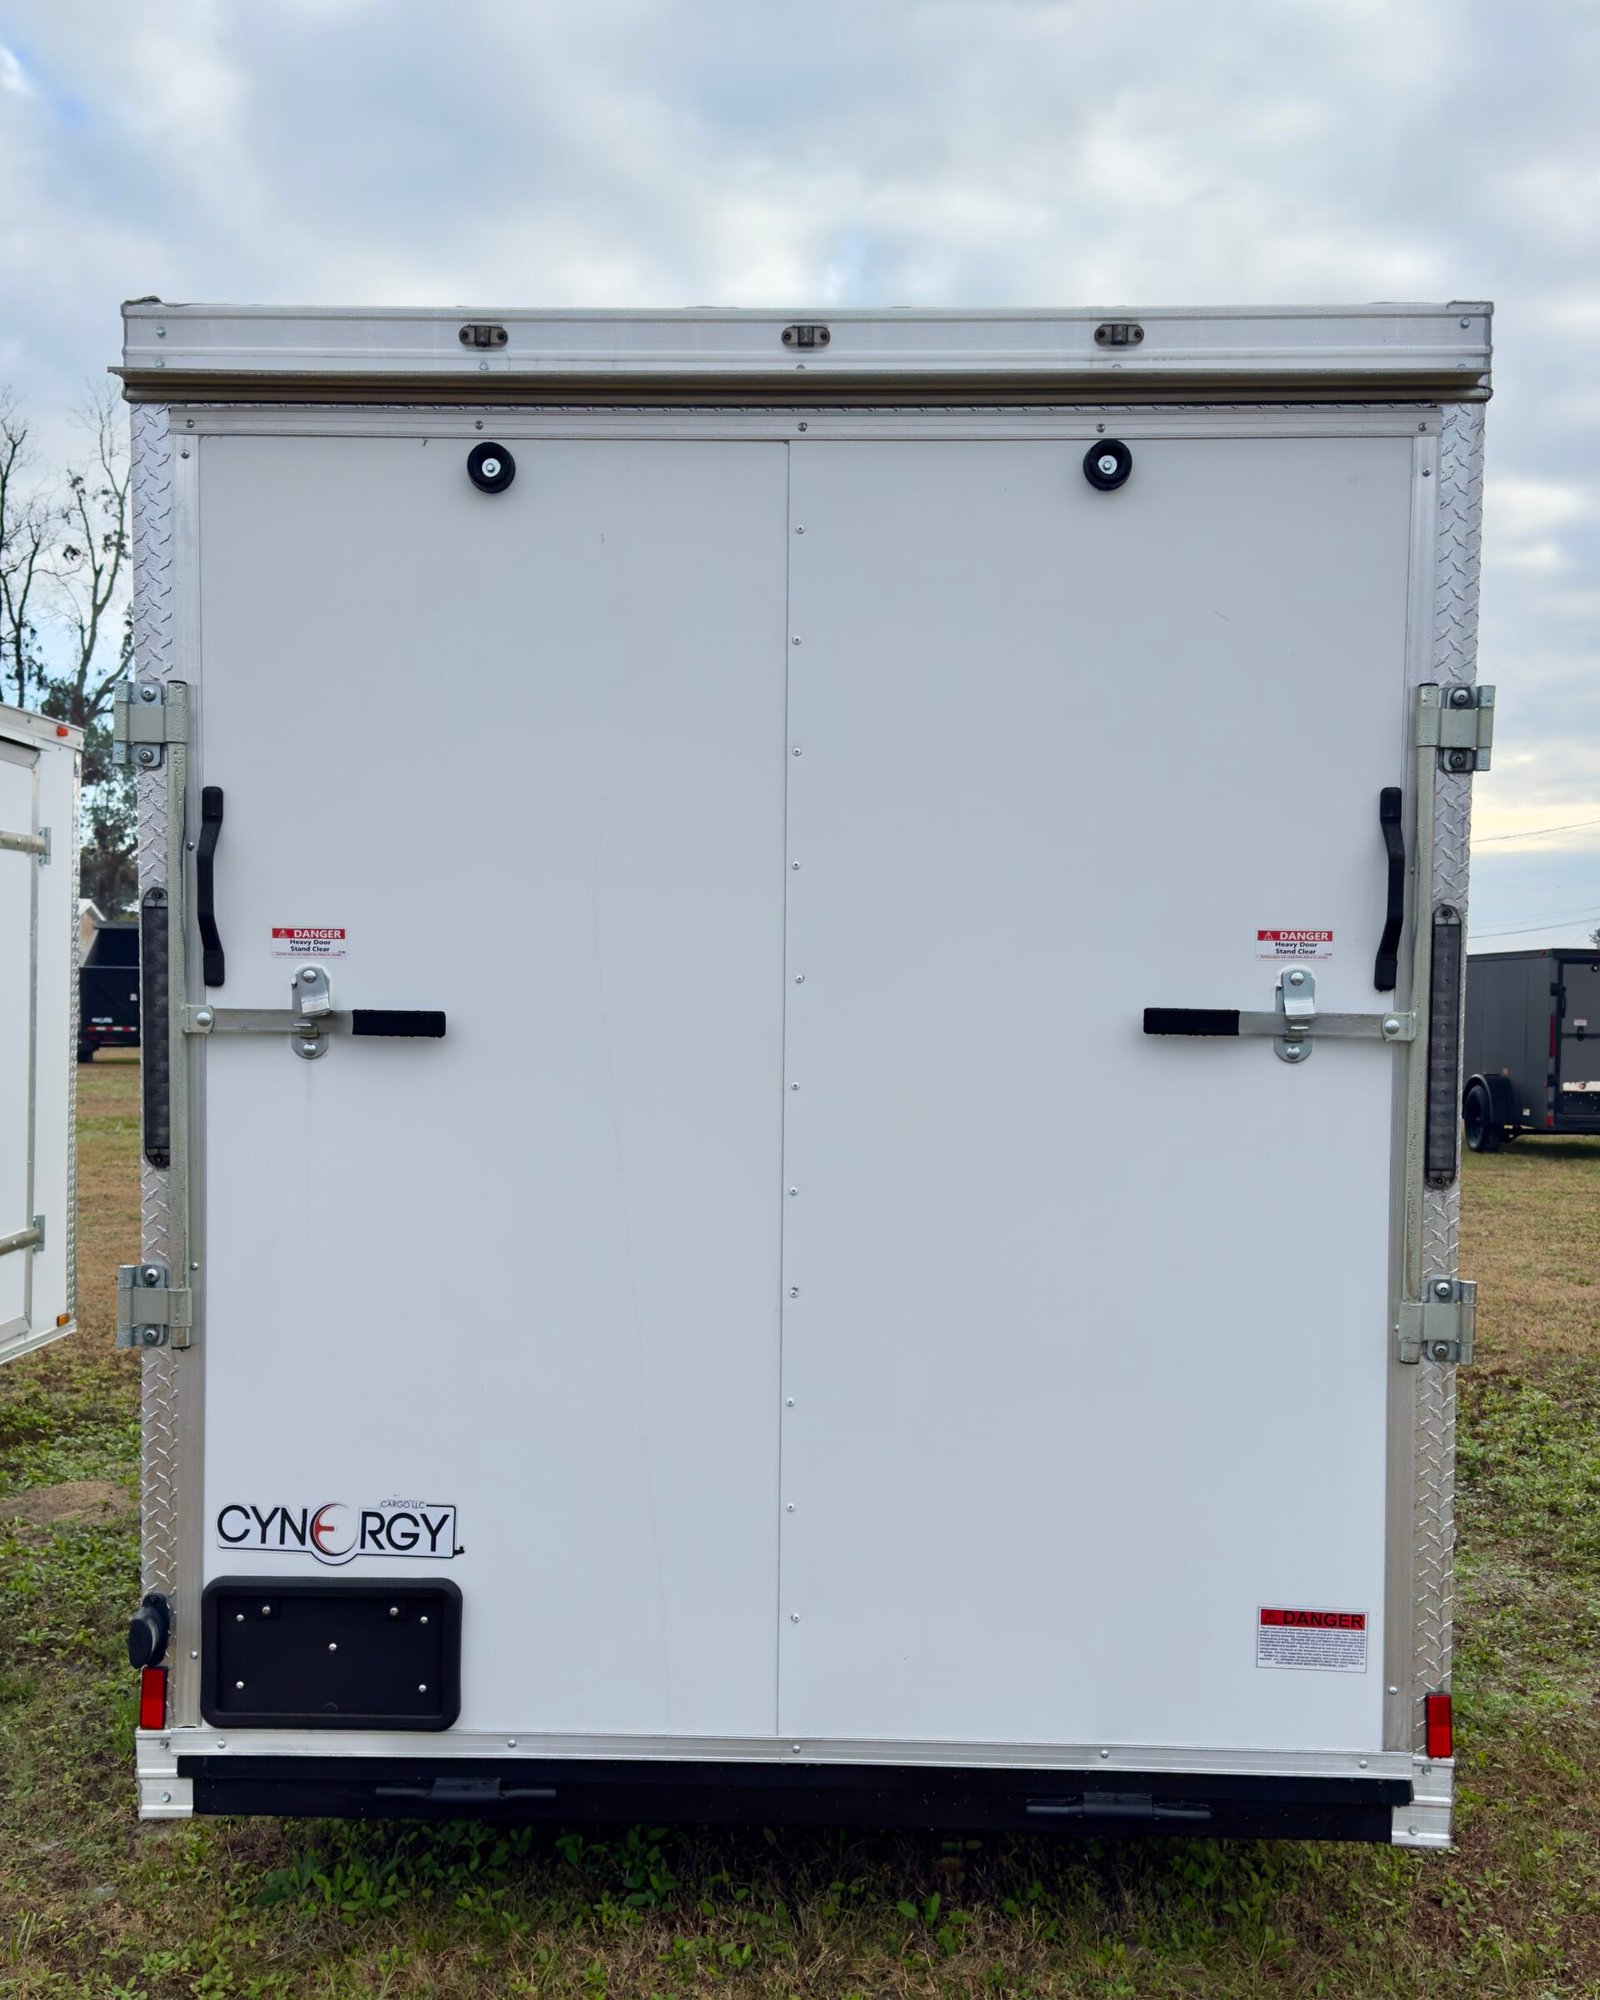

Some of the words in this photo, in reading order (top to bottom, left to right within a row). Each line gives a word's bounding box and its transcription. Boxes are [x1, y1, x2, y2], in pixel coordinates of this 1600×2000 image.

[293, 929, 341, 938] DANGER
[1279, 932, 1329, 940] DANGER
[380, 1500, 410, 1509] CARGO
[411, 1501, 426, 1509] LLC
[217, 1503, 450, 1556] CYNERGY
[1283, 1610, 1363, 1629] DANGER
